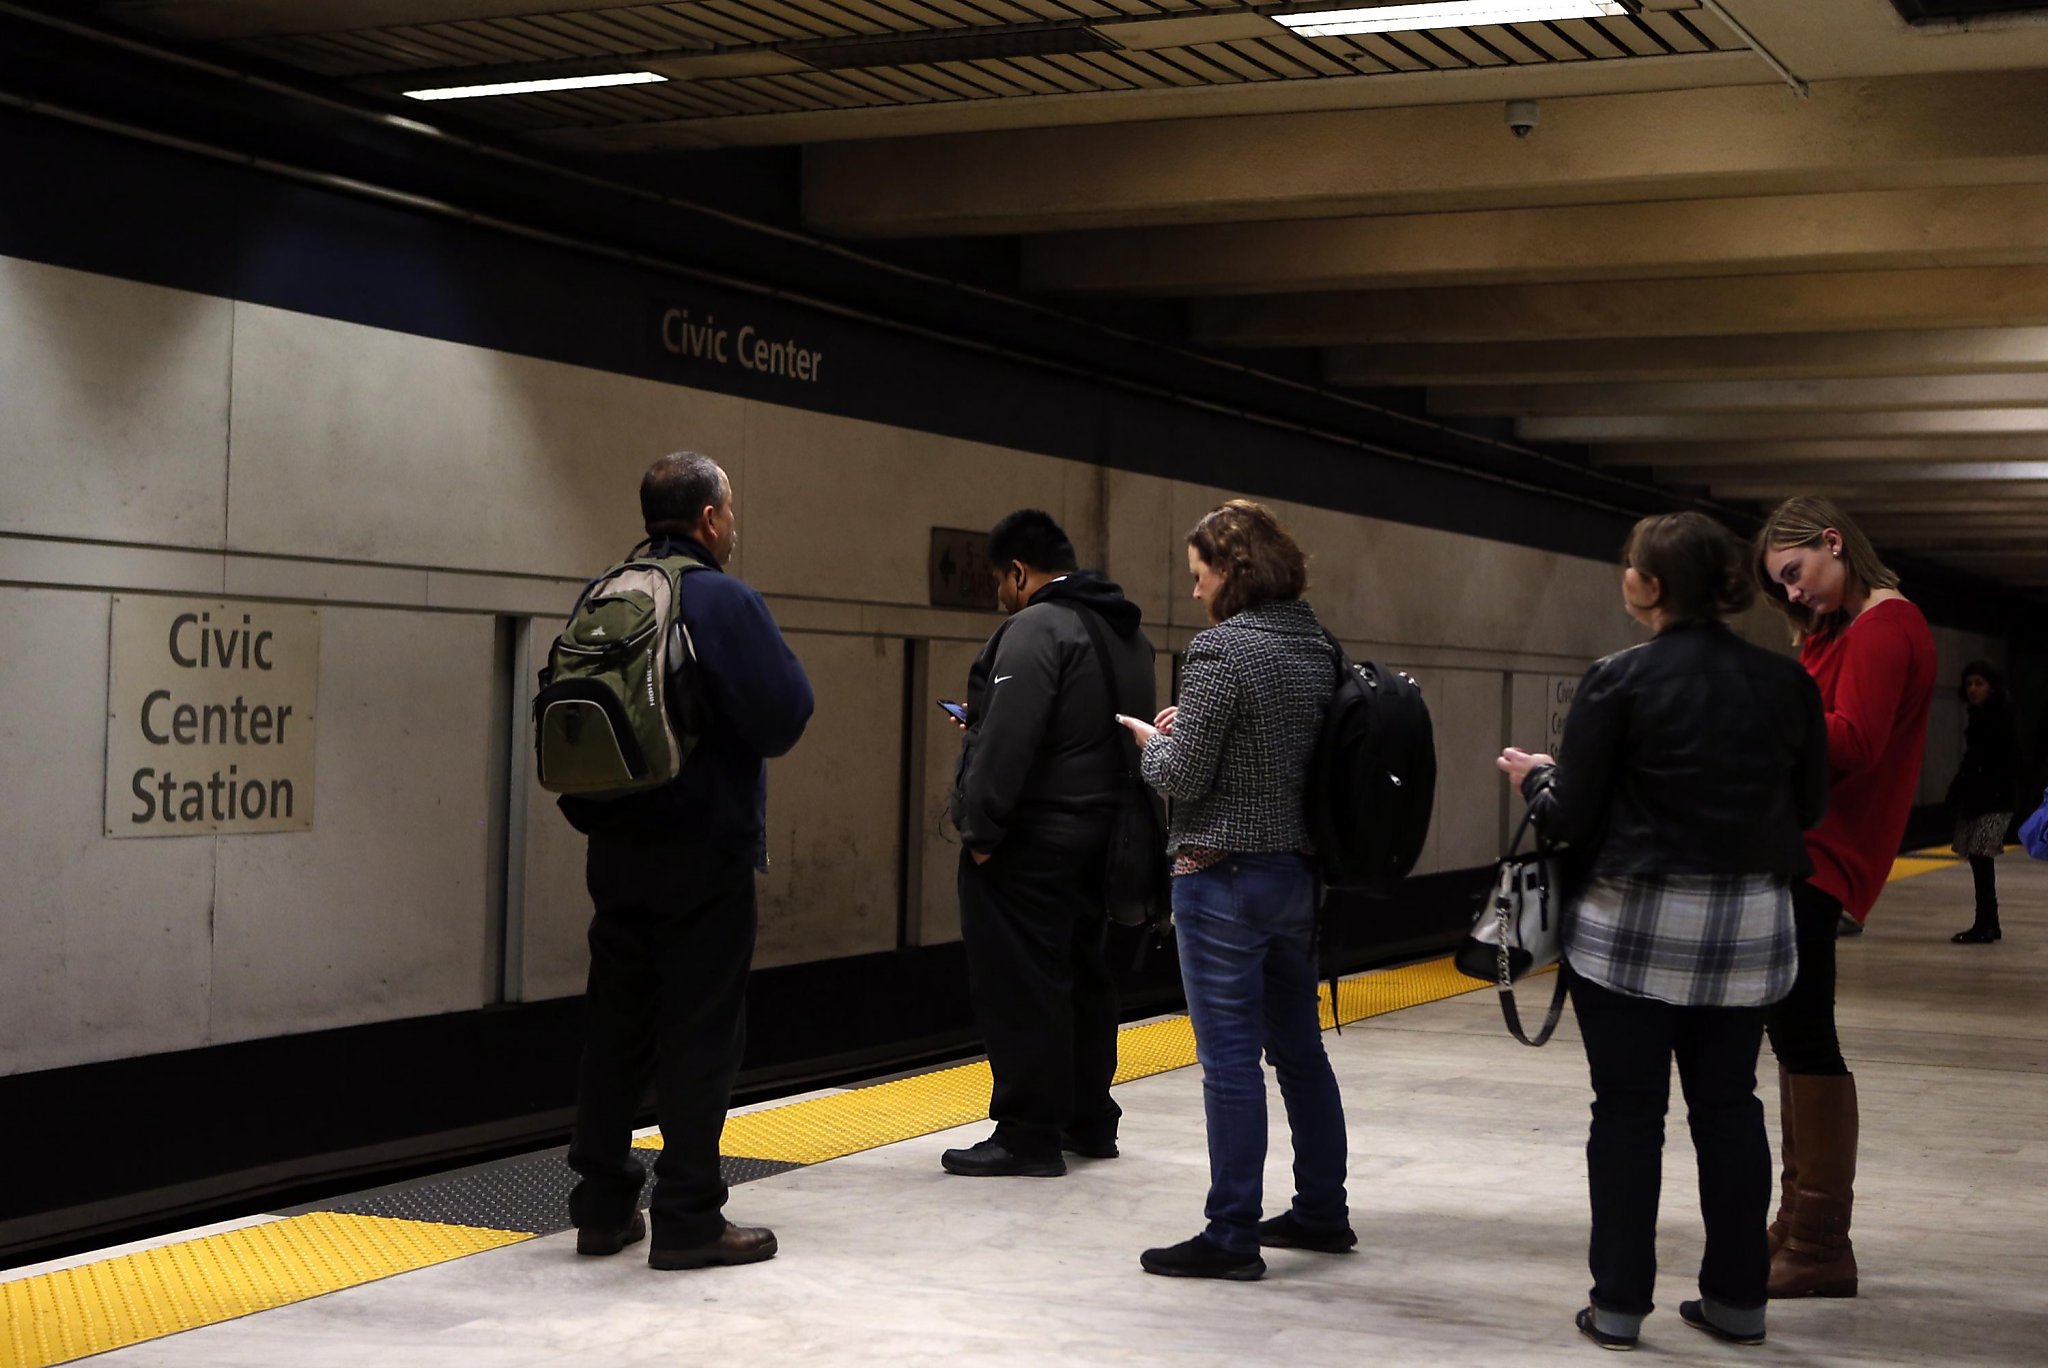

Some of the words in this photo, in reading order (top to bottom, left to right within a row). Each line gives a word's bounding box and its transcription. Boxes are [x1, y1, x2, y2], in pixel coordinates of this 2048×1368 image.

[662, 308, 728, 364] Civic
[737, 325, 822, 382] Center
[169, 612, 273, 670] Civic
[141, 690, 292, 745] Center
[131, 765, 294, 824] Station
